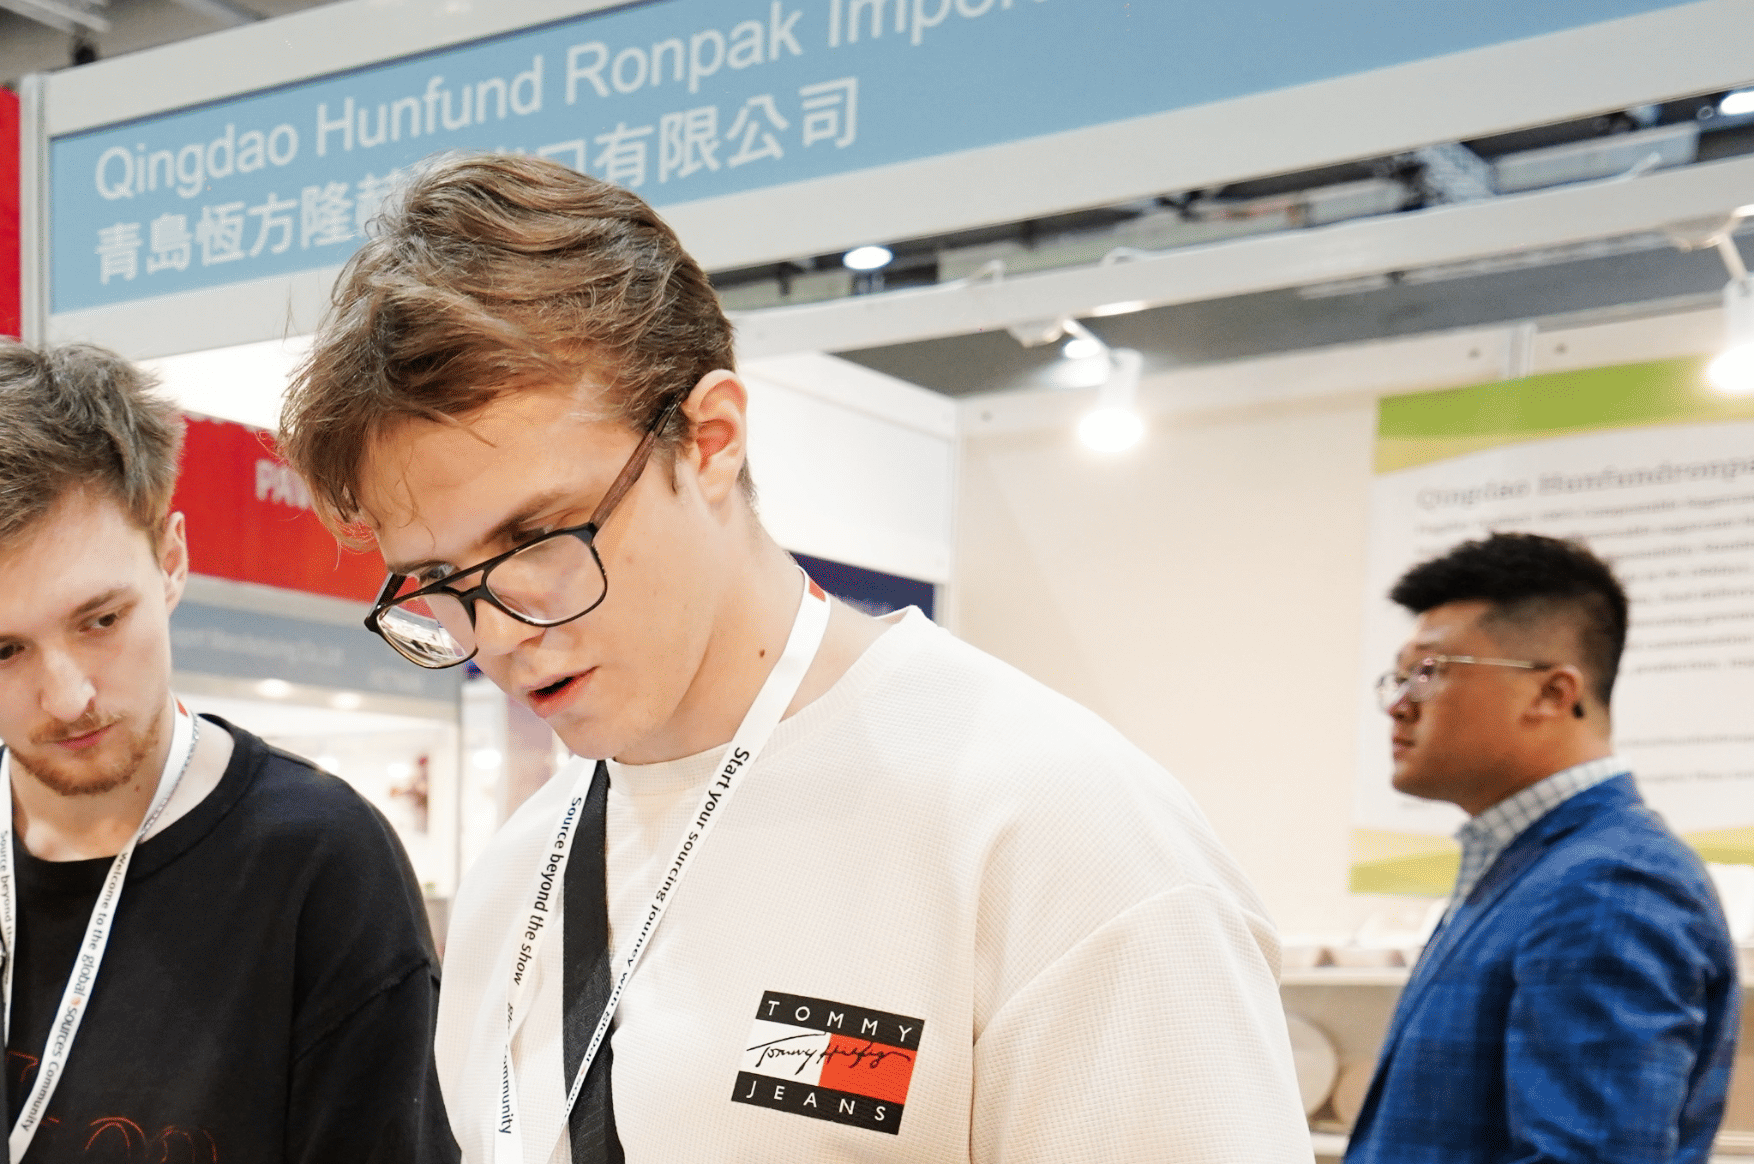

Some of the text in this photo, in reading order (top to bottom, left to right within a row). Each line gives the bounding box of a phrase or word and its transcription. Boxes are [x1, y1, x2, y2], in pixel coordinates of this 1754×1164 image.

[95, 122, 299, 200] Qingdao
[316, 53, 543, 157] Hunfund
[565, 0, 804, 105] Ronpak
[716, 747, 750, 790] Start
[696, 789, 722, 830] your
[0, 830, 9, 873] Source
[655, 831, 699, 904] sourcing
[0, 875, 12, 923] beyond
[513, 796, 582, 986] Source beyond the show
[627, 903, 662, 967] journey
[20, 852, 128, 1132] Welcome to the global sources Community
[767, 999, 913, 1043] TOMMY
[746, 1080, 887, 1122] JEANS
